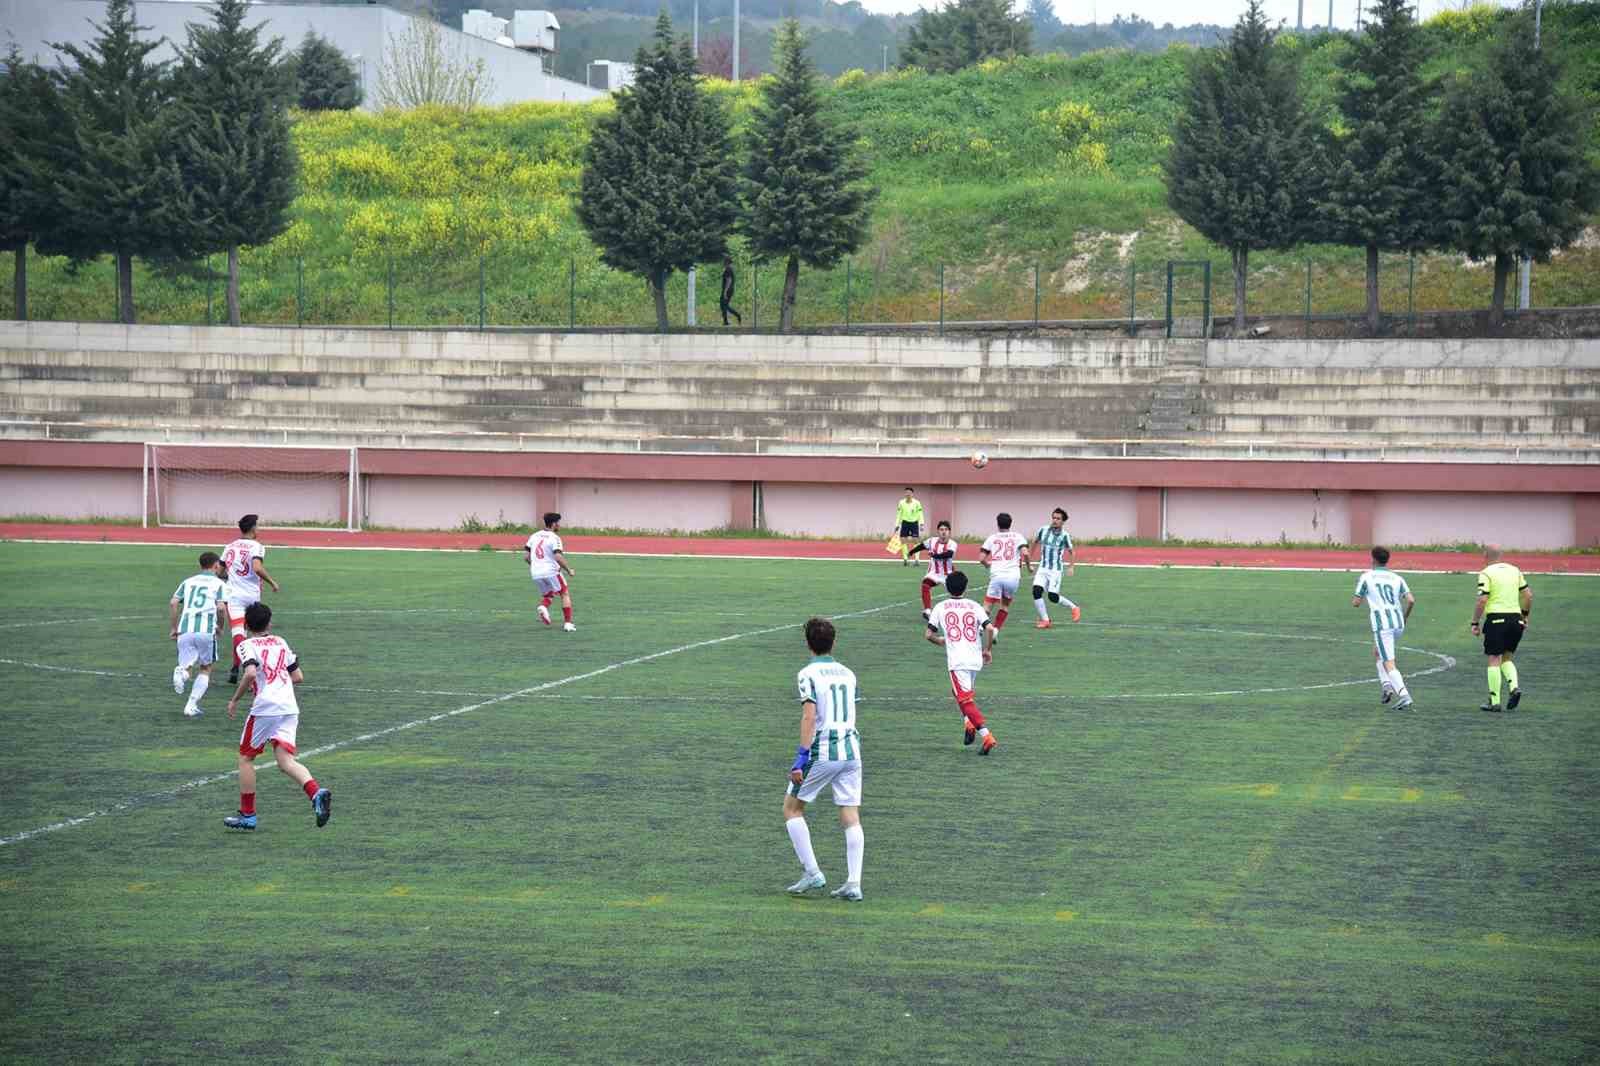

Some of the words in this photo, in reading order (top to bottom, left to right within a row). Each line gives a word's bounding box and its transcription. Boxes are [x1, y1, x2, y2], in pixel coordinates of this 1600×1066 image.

[991, 539, 1015, 561] 28
[187, 585, 209, 609] 15
[1375, 583, 1396, 605] 10
[944, 611, 977, 642] 88
[829, 683, 849, 722] 11
